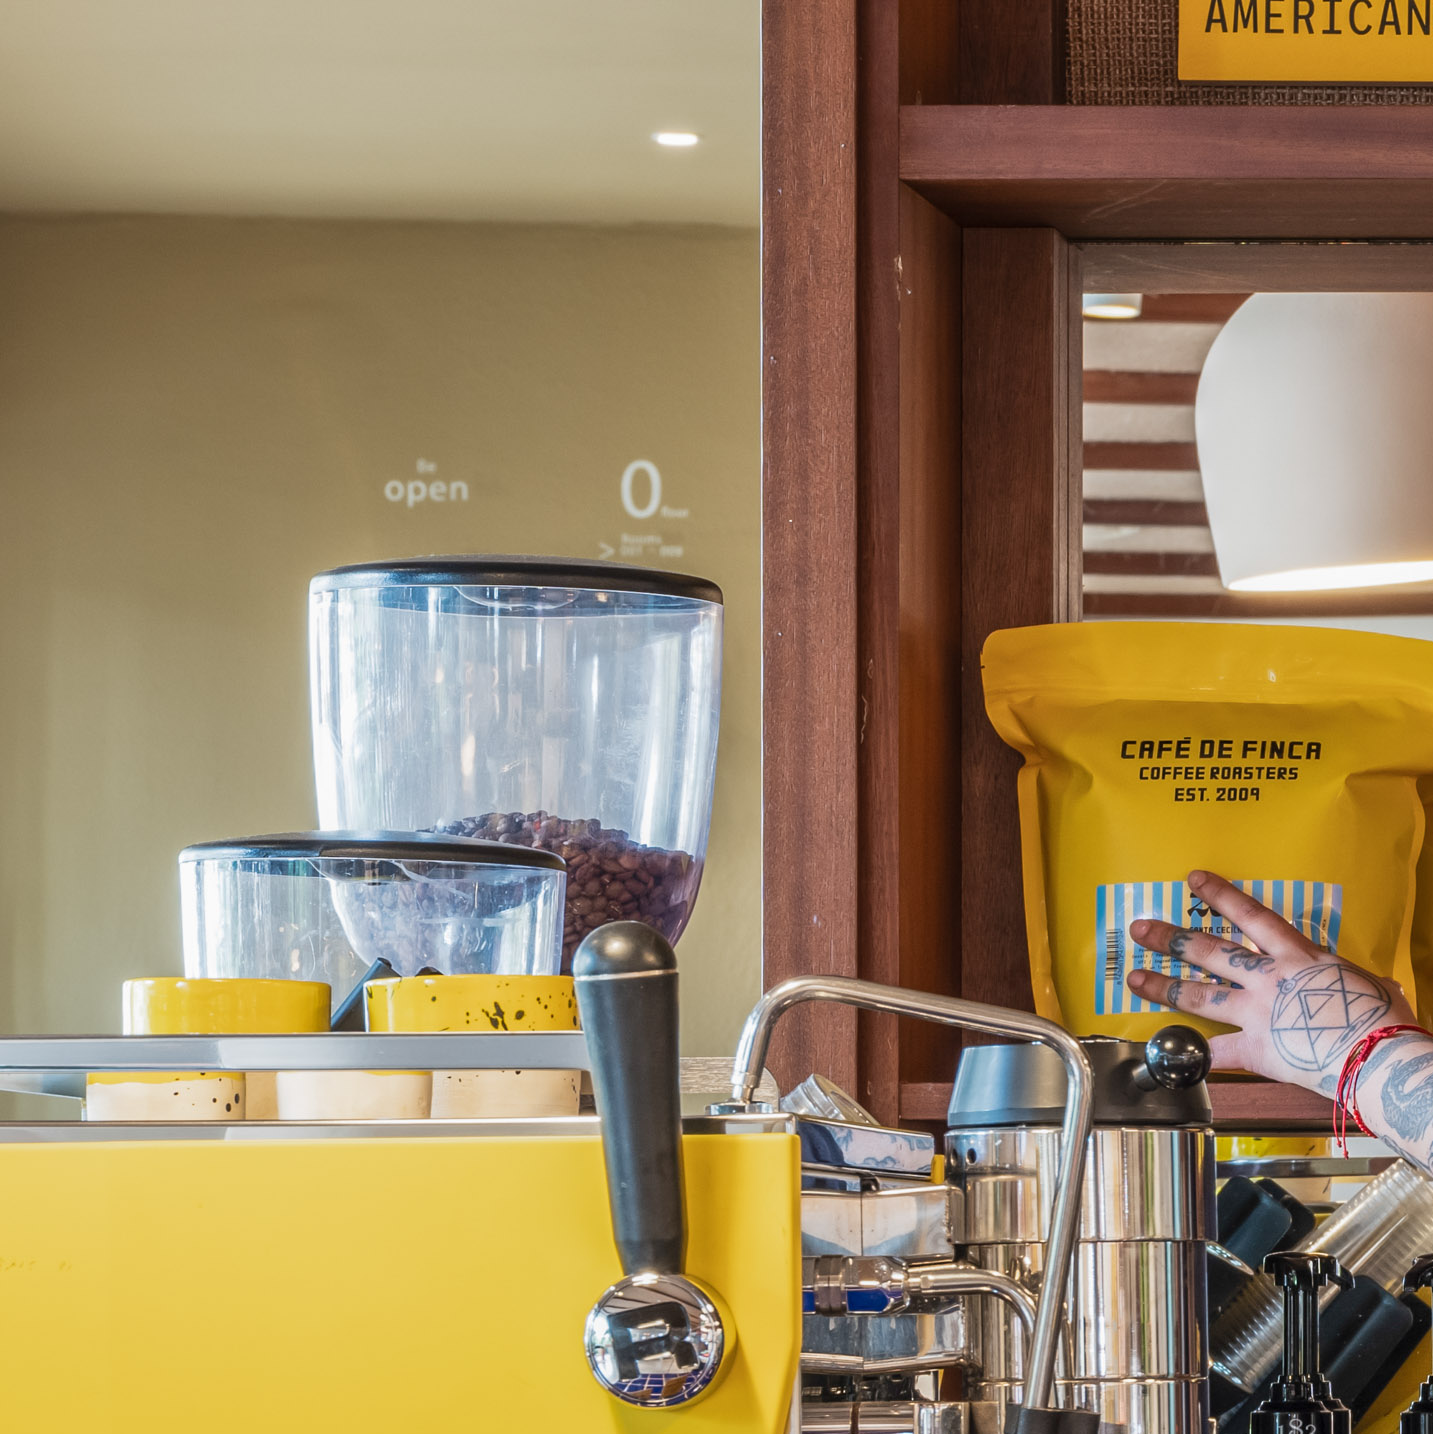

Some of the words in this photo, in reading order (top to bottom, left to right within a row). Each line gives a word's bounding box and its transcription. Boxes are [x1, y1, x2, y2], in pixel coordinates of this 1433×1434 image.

[384, 480, 469, 509] open
[620, 459, 662, 518] 0
[1120, 737, 1191, 760] CAFÉ
[1199, 740, 1233, 760] DE
[1240, 740, 1321, 760] FINCA
[1139, 767, 1205, 780] COFFEE
[1209, 767, 1298, 780] ROASTERS
[1173, 787, 1210, 802] EST.
[1216, 787, 1260, 802] 2009
